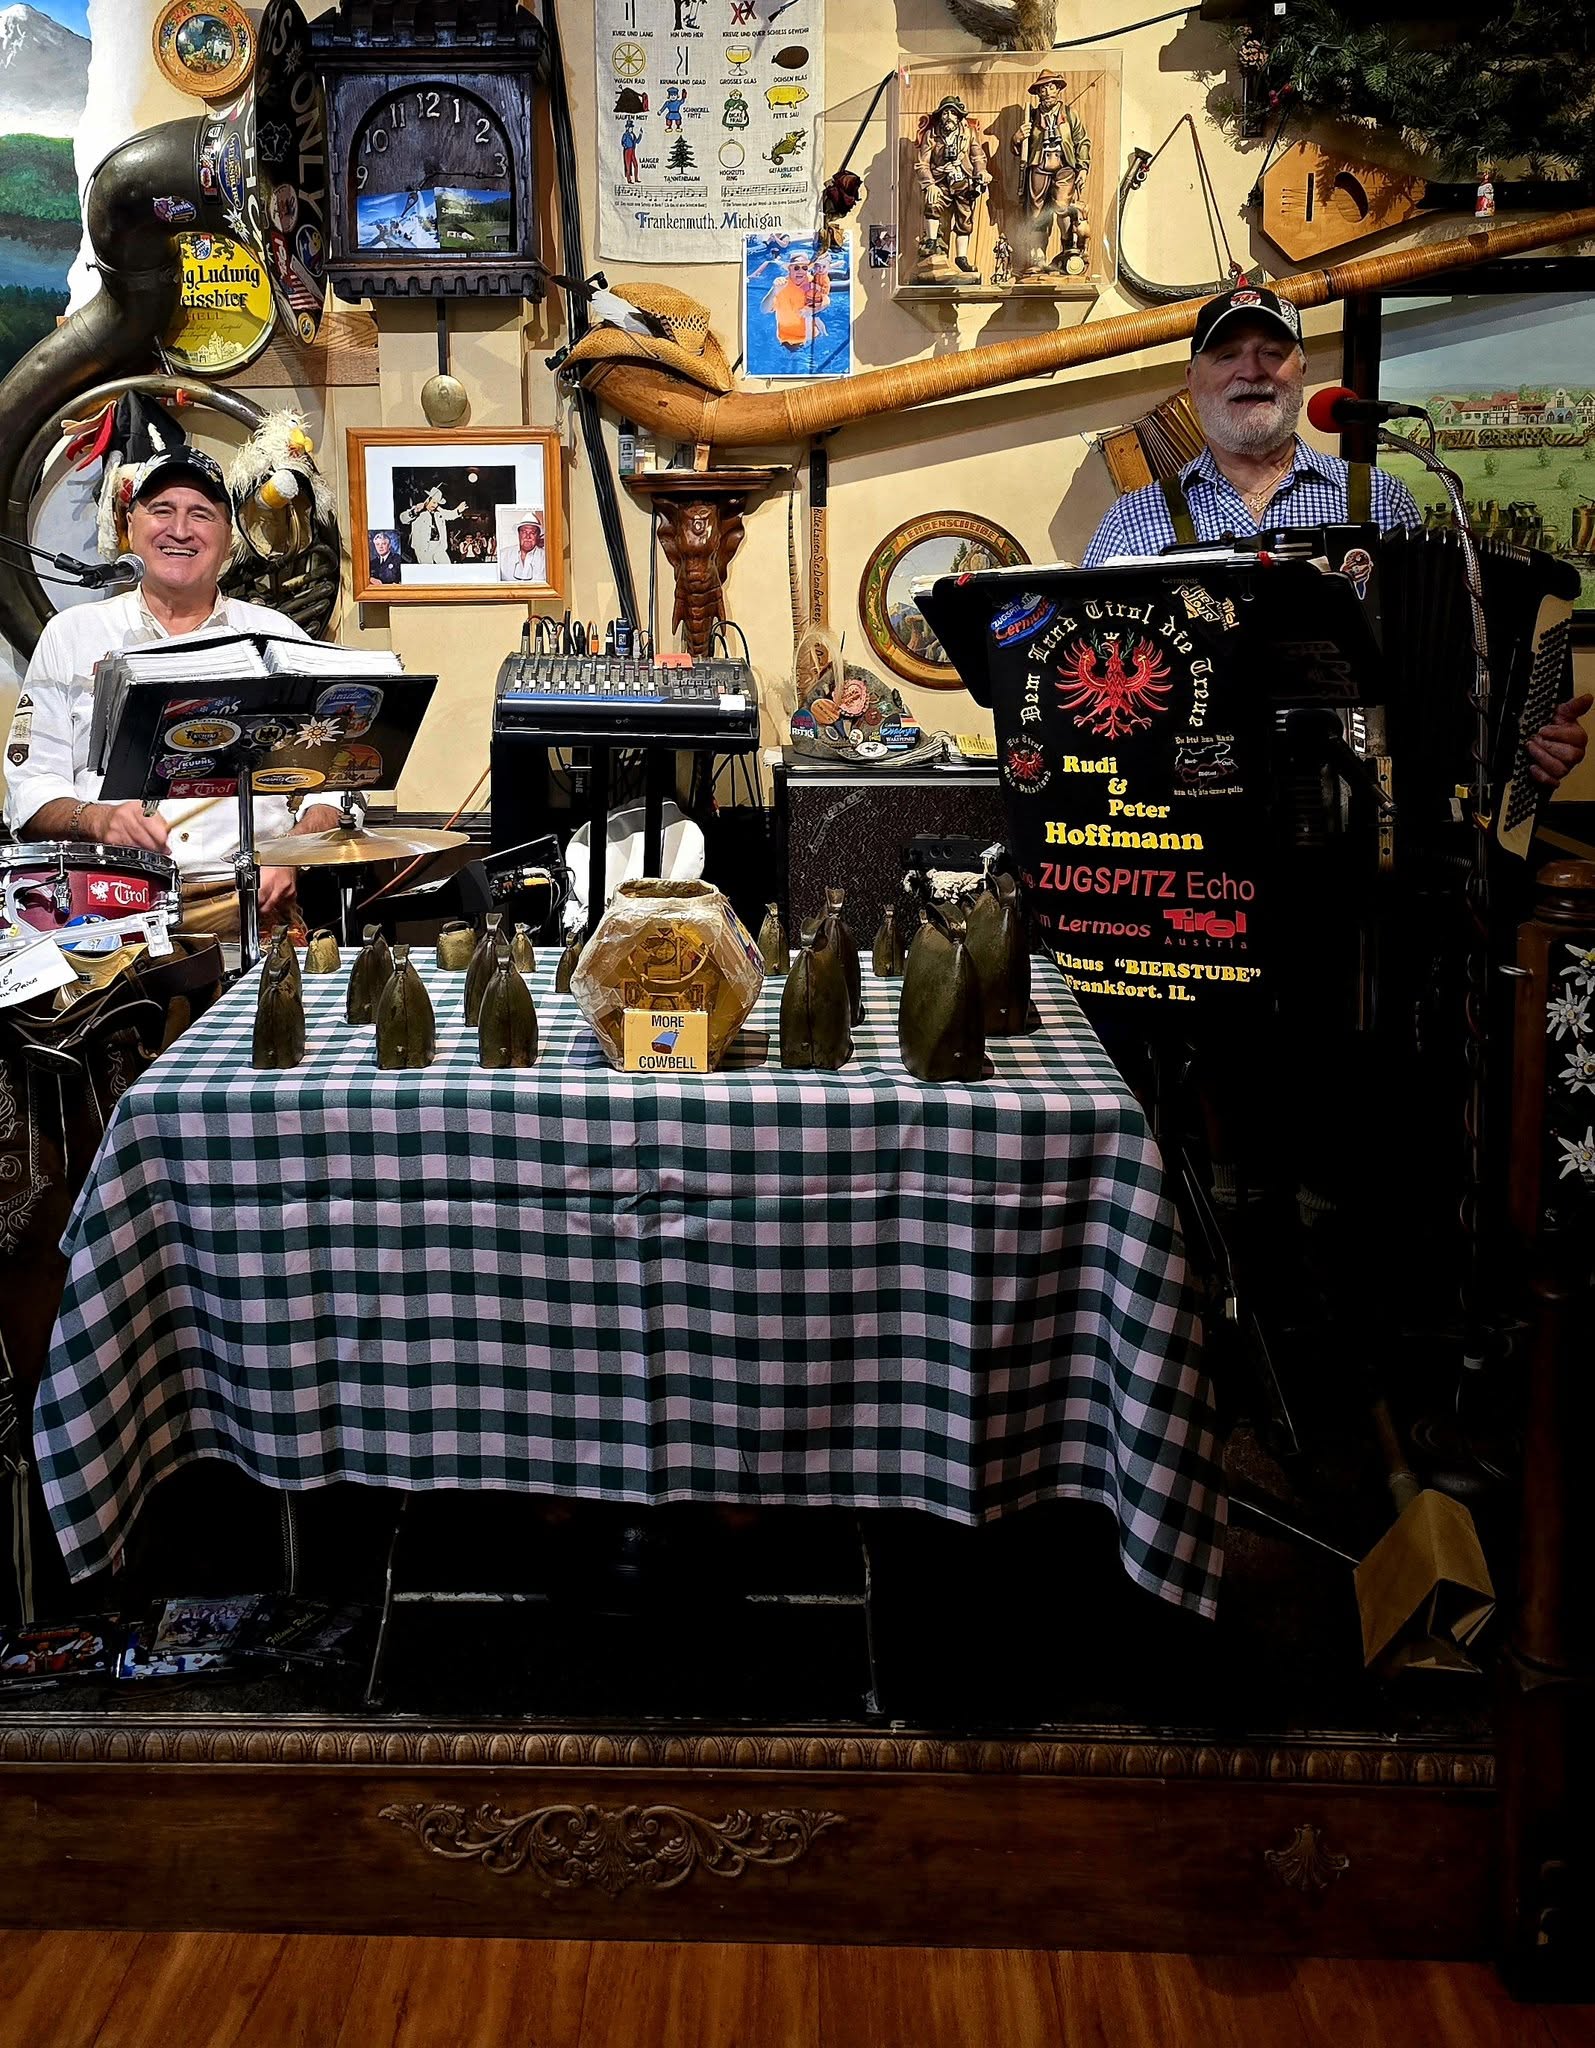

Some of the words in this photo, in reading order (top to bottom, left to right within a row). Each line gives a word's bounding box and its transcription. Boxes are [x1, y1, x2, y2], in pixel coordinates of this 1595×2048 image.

[390, 102, 406, 128] 11
[416, 92, 440, 118] 12
[453, 98, 461, 124] 1
[364, 128, 388, 154] 10
[475, 118, 490, 144] 2
[291, 70, 325, 223] ONLY
[494, 152, 507, 178] 3
[356, 166, 368, 190] 9
[720, 212, 782, 230] Michigan
[195, 264, 260, 290] Ludwig
[182, 289, 248, 308] eissbier
[907, 520, 997, 540] EHRENSCHEIBE
[1084, 600, 1155, 625] Tirol
[1159, 616, 1193, 654] die
[1062, 755, 1118, 775] Rudi
[192, 781, 237, 797] Tirol
[1107, 778, 1128, 796] &
[1108, 798, 1170, 818] Peter
[1044, 821, 1204, 850] Hoffmann
[110, 880, 149, 905] Tirol
[1039, 862, 1177, 898] ZUGSPITZ
[1187, 872, 1256, 901] Echo
[1058, 914, 1151, 938] Lermoos
[1163, 908, 1247, 938] Tirol
[1164, 936, 1248, 950] Austria
[1056, 951, 1104, 972] Klaus
[1064, 974, 1162, 1000] Frankfort.
[1168, 985, 1196, 1002] IL.
[652, 1014, 684, 1028] MORE
[639, 1056, 696, 1069] COWBELL
